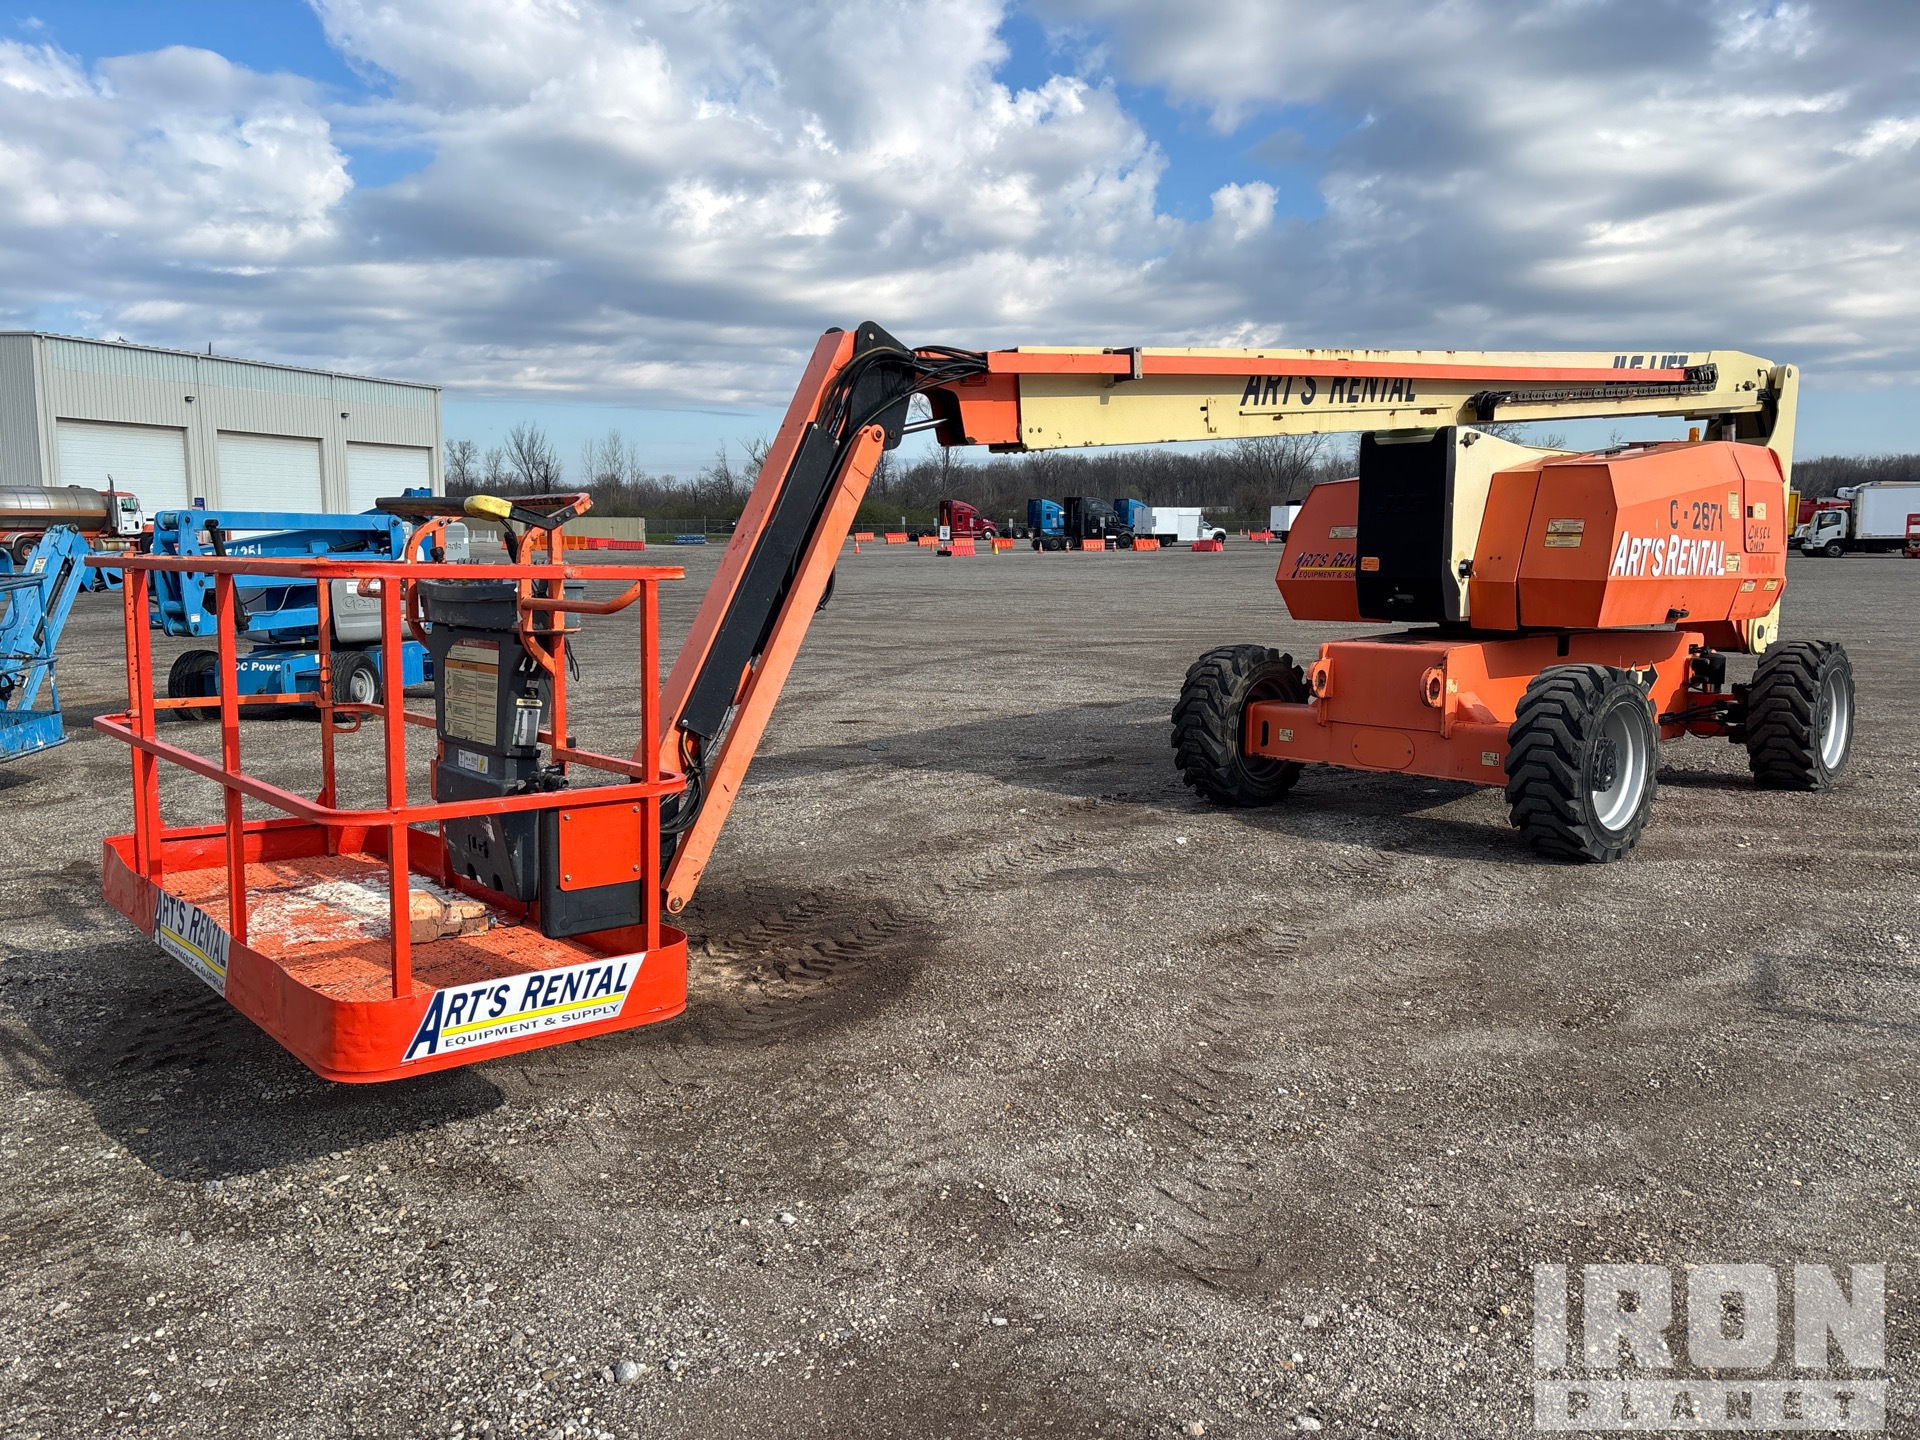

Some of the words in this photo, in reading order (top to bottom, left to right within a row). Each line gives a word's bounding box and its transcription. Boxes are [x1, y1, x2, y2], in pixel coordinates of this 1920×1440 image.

[1330, 552, 1356, 568] REN
[1609, 531, 1665, 577] ART'S
[1664, 534, 1725, 576] RENTAL
[1299, 571, 1336, 579] EQUIPMENT
[251, 662, 281, 672] Powe
[153, 888, 186, 946] ART'S
[188, 907, 226, 967] RENTAL
[162, 938, 194, 967] EQUIPMENT
[405, 984, 511, 1060] ART'S
[519, 962, 628, 1012] RENTAL
[445, 1021, 537, 1048] EQUIPMENT
[544, 1017, 556, 1026] &
[561, 1004, 619, 1023] SUPPLY
